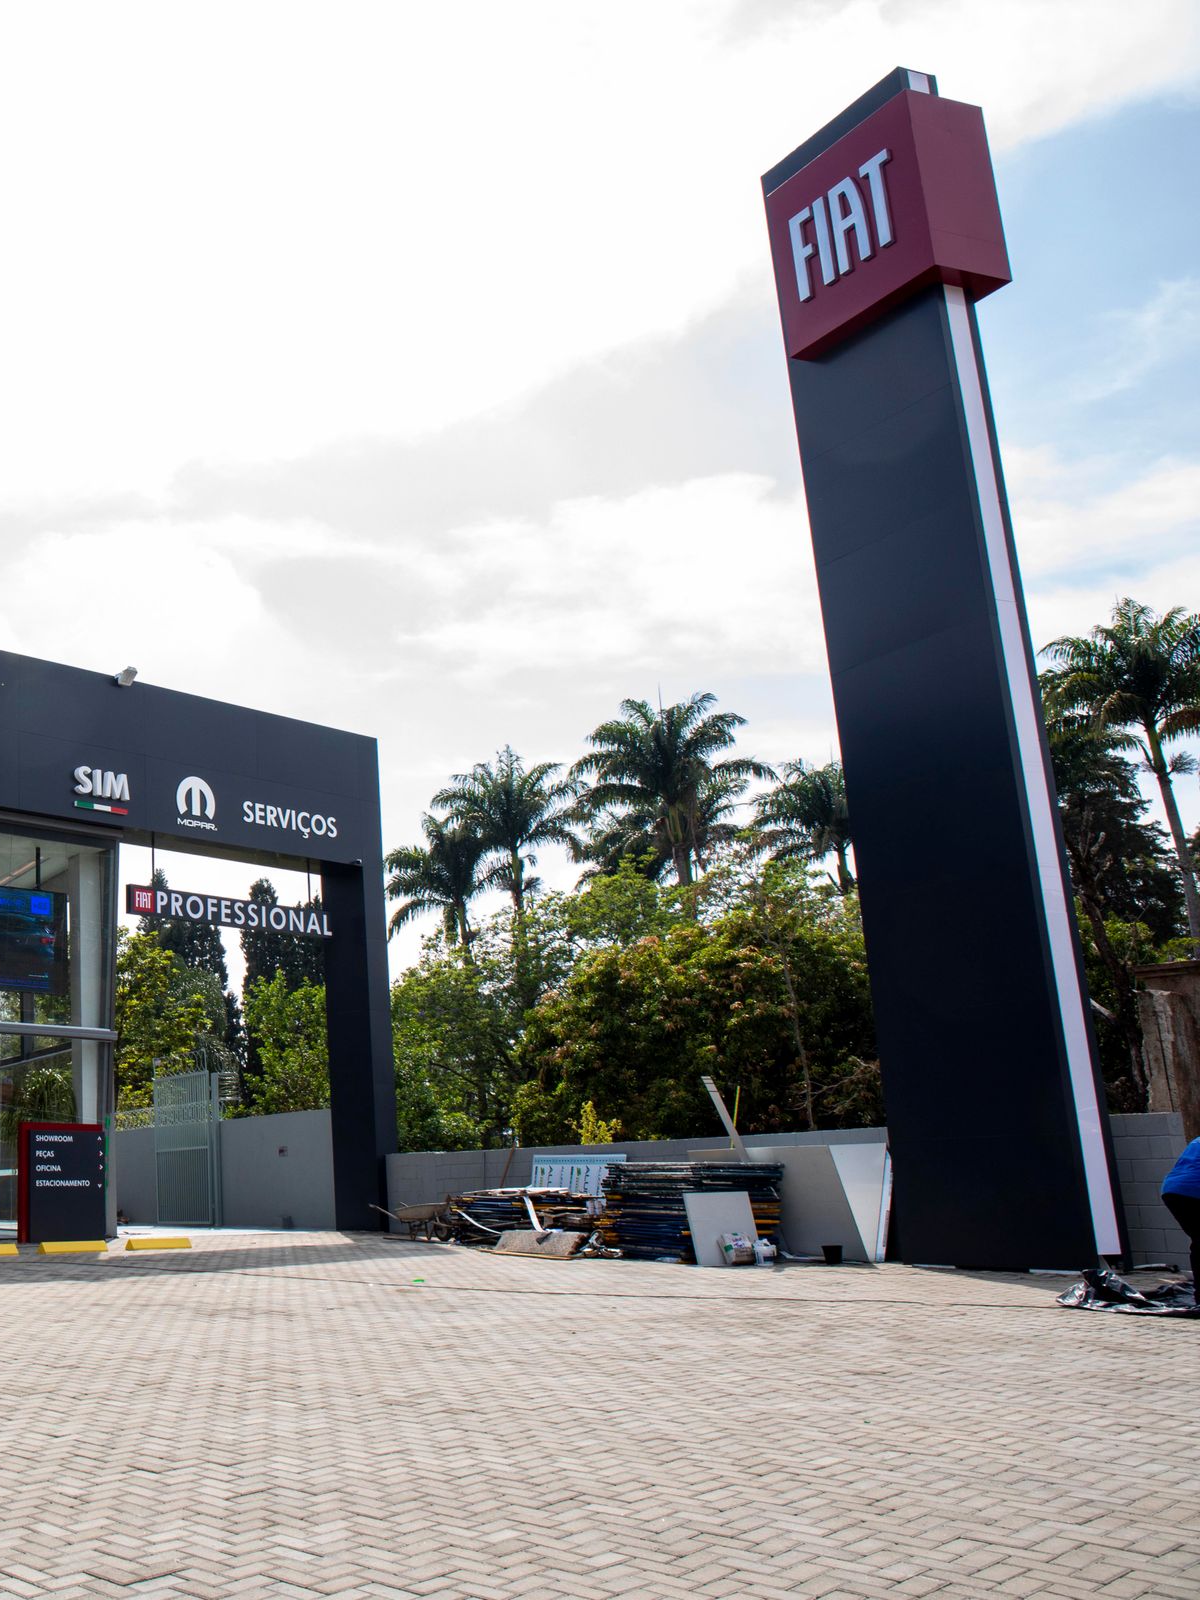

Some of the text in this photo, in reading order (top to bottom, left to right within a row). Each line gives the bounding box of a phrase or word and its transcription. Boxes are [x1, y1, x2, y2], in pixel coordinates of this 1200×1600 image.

[788, 148, 895, 303] FIAT
[73, 765, 131, 801] SIM
[242, 800, 338, 839] SERVIÇOS
[135, 891, 333, 937] FIAT PROFESSIONAL
[35, 1134, 73, 1142] SHOWROOM
[35, 1150, 55, 1158] PEÇAS
[35, 1164, 61, 1172] OFICINA
[35, 1179, 90, 1187] ESTACIONAMENTO
